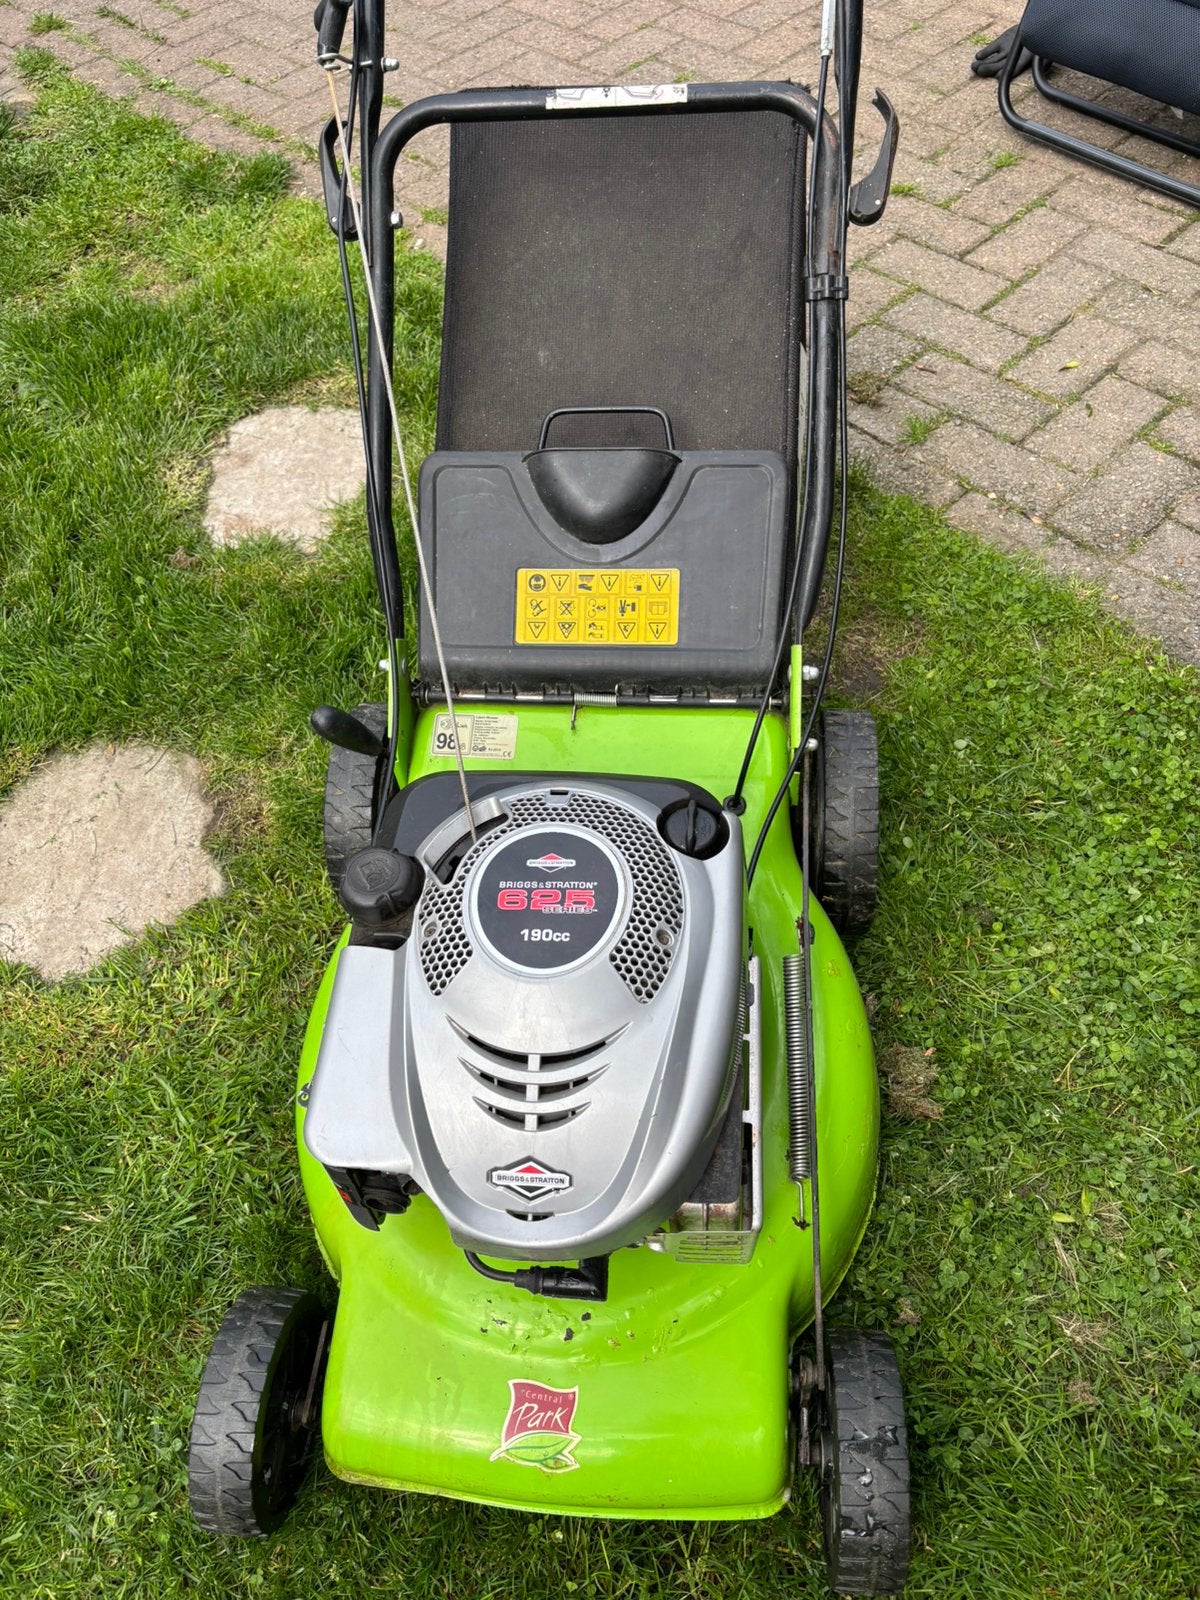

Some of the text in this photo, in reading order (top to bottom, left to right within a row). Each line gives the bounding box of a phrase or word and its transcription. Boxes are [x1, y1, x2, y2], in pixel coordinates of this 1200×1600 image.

[497, 889, 596, 911] 625
[542, 905, 594, 914] SERIES
[520, 928, 571, 942] 190cc
[496, 1175, 565, 1184] BRIGGS&STRATTON
[525, 1390, 563, 1404] Central
[512, 1402, 569, 1435] Park
